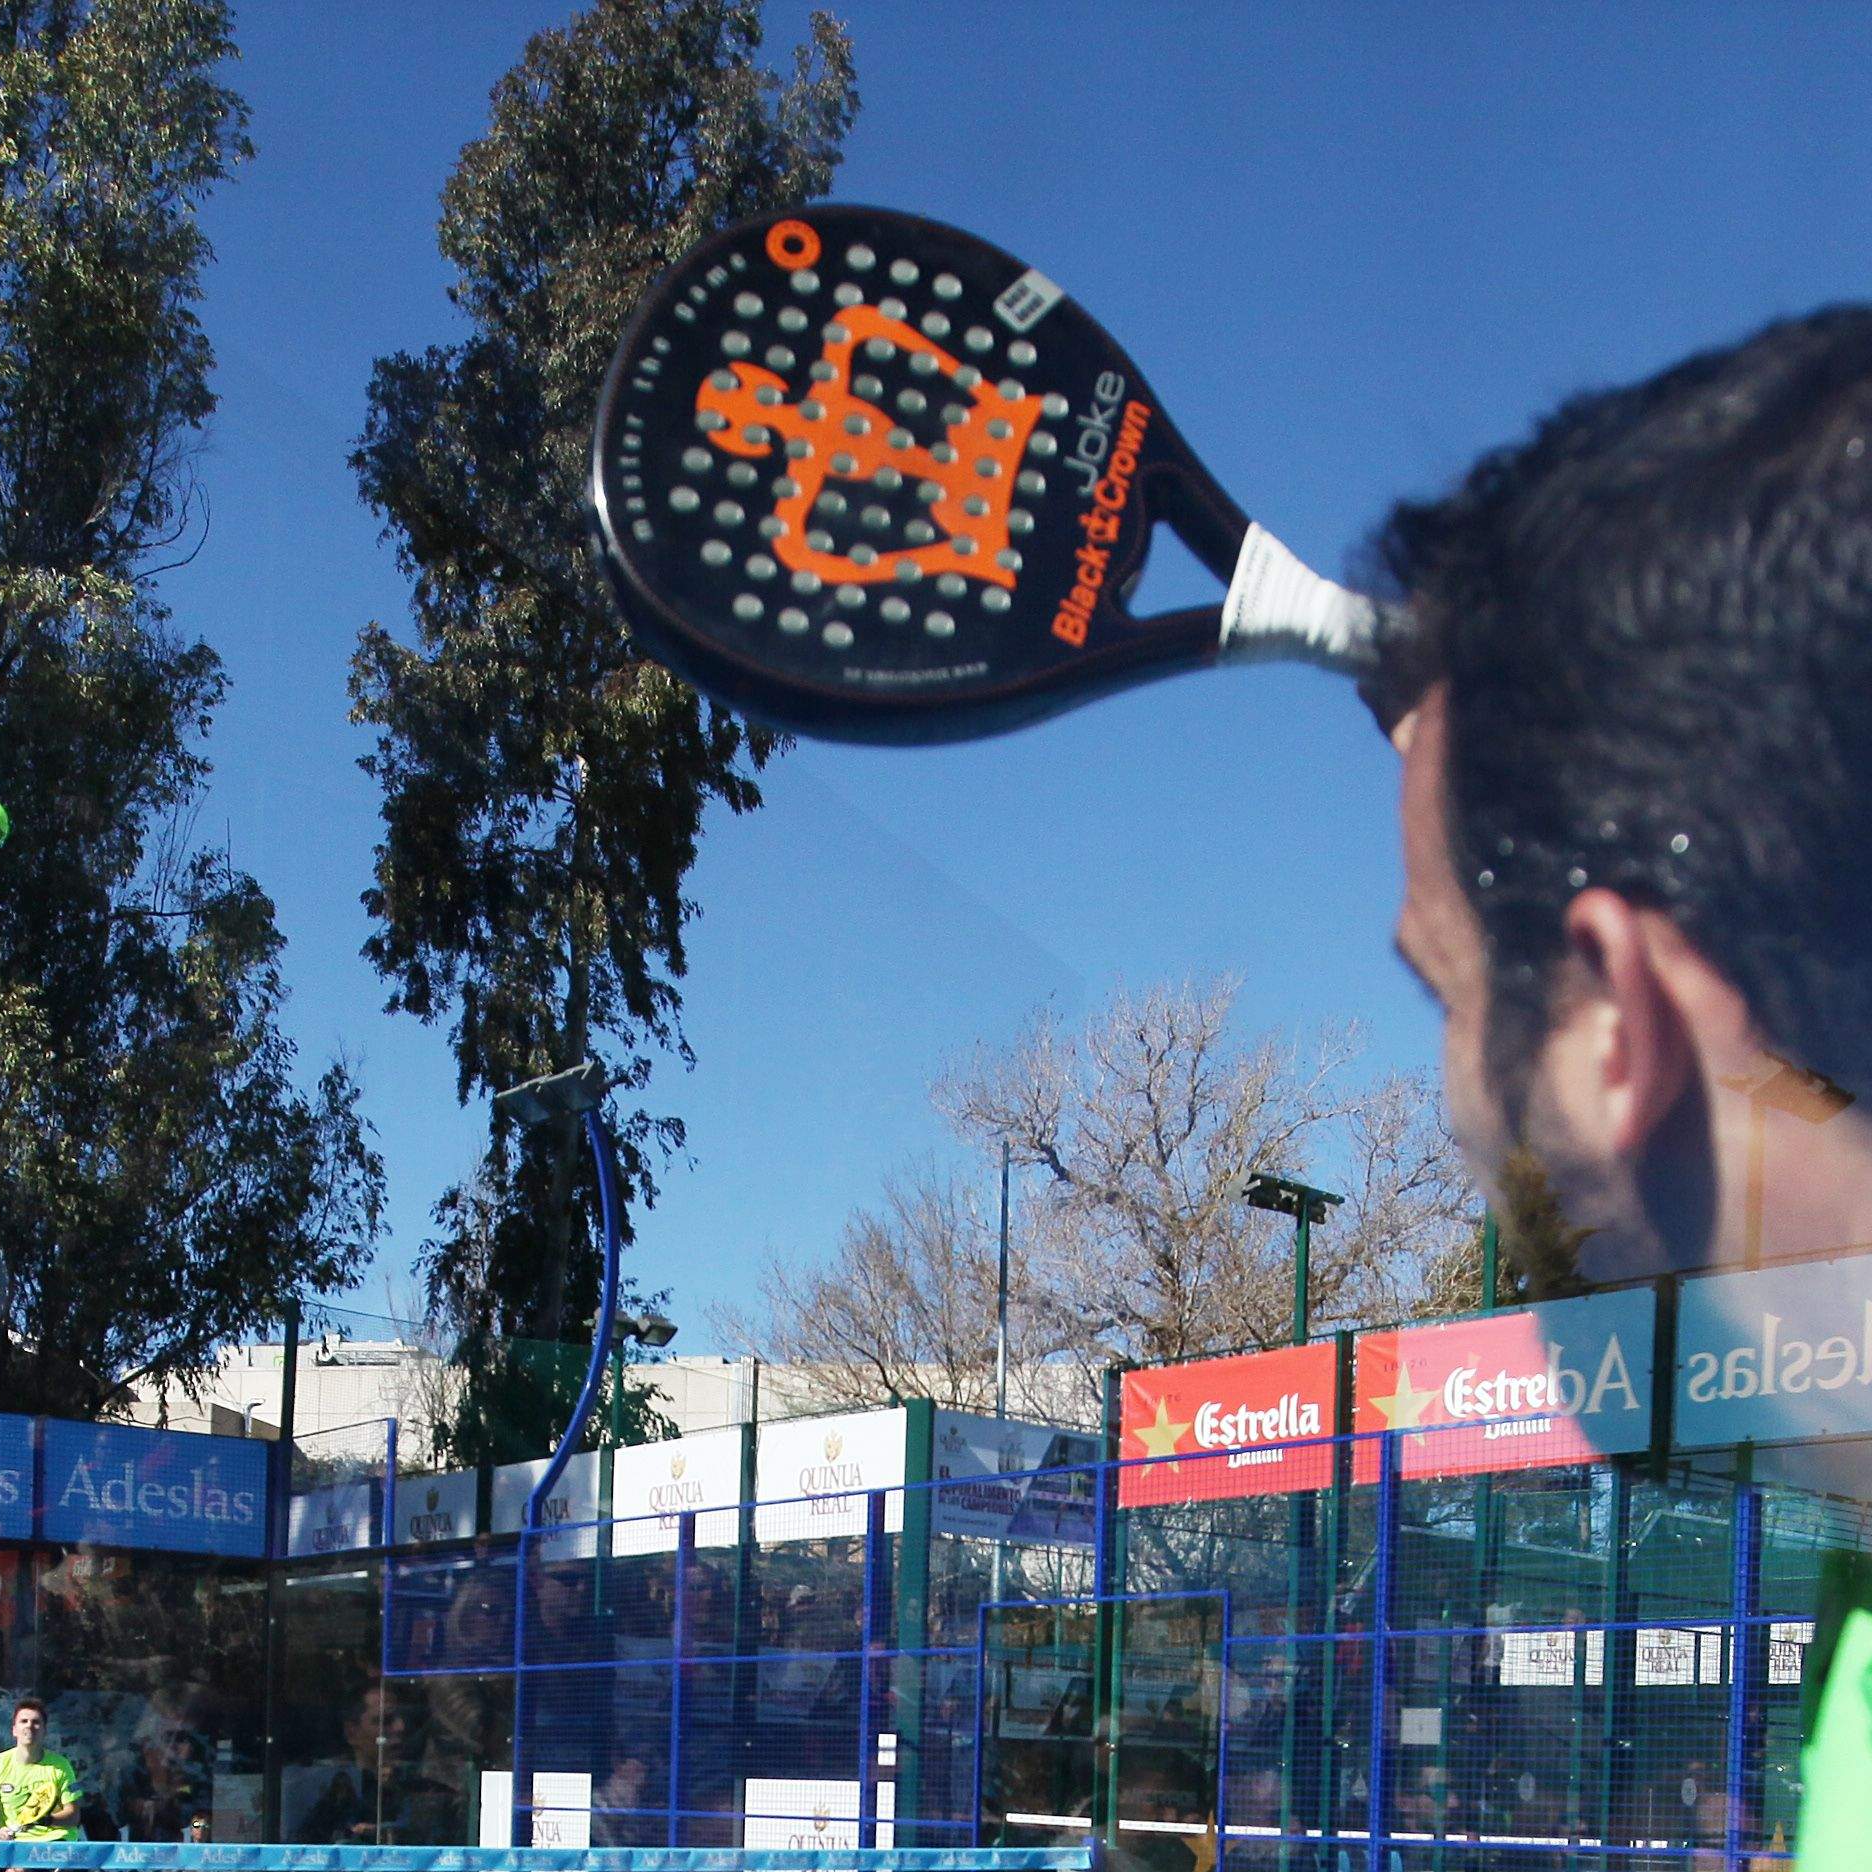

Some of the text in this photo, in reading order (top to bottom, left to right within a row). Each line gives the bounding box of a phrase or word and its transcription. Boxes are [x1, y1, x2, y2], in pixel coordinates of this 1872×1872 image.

[1062, 369, 1126, 497] Joke
[1050, 399, 1153, 648] Black Crown
[1193, 1392, 1321, 1448] Estrella
[1443, 1365, 1560, 1419] Estrel
[56, 1454, 255, 1525] Adeslas
[648, 1480, 705, 1511] QUINUA
[798, 1463, 863, 1497] QUINUA
